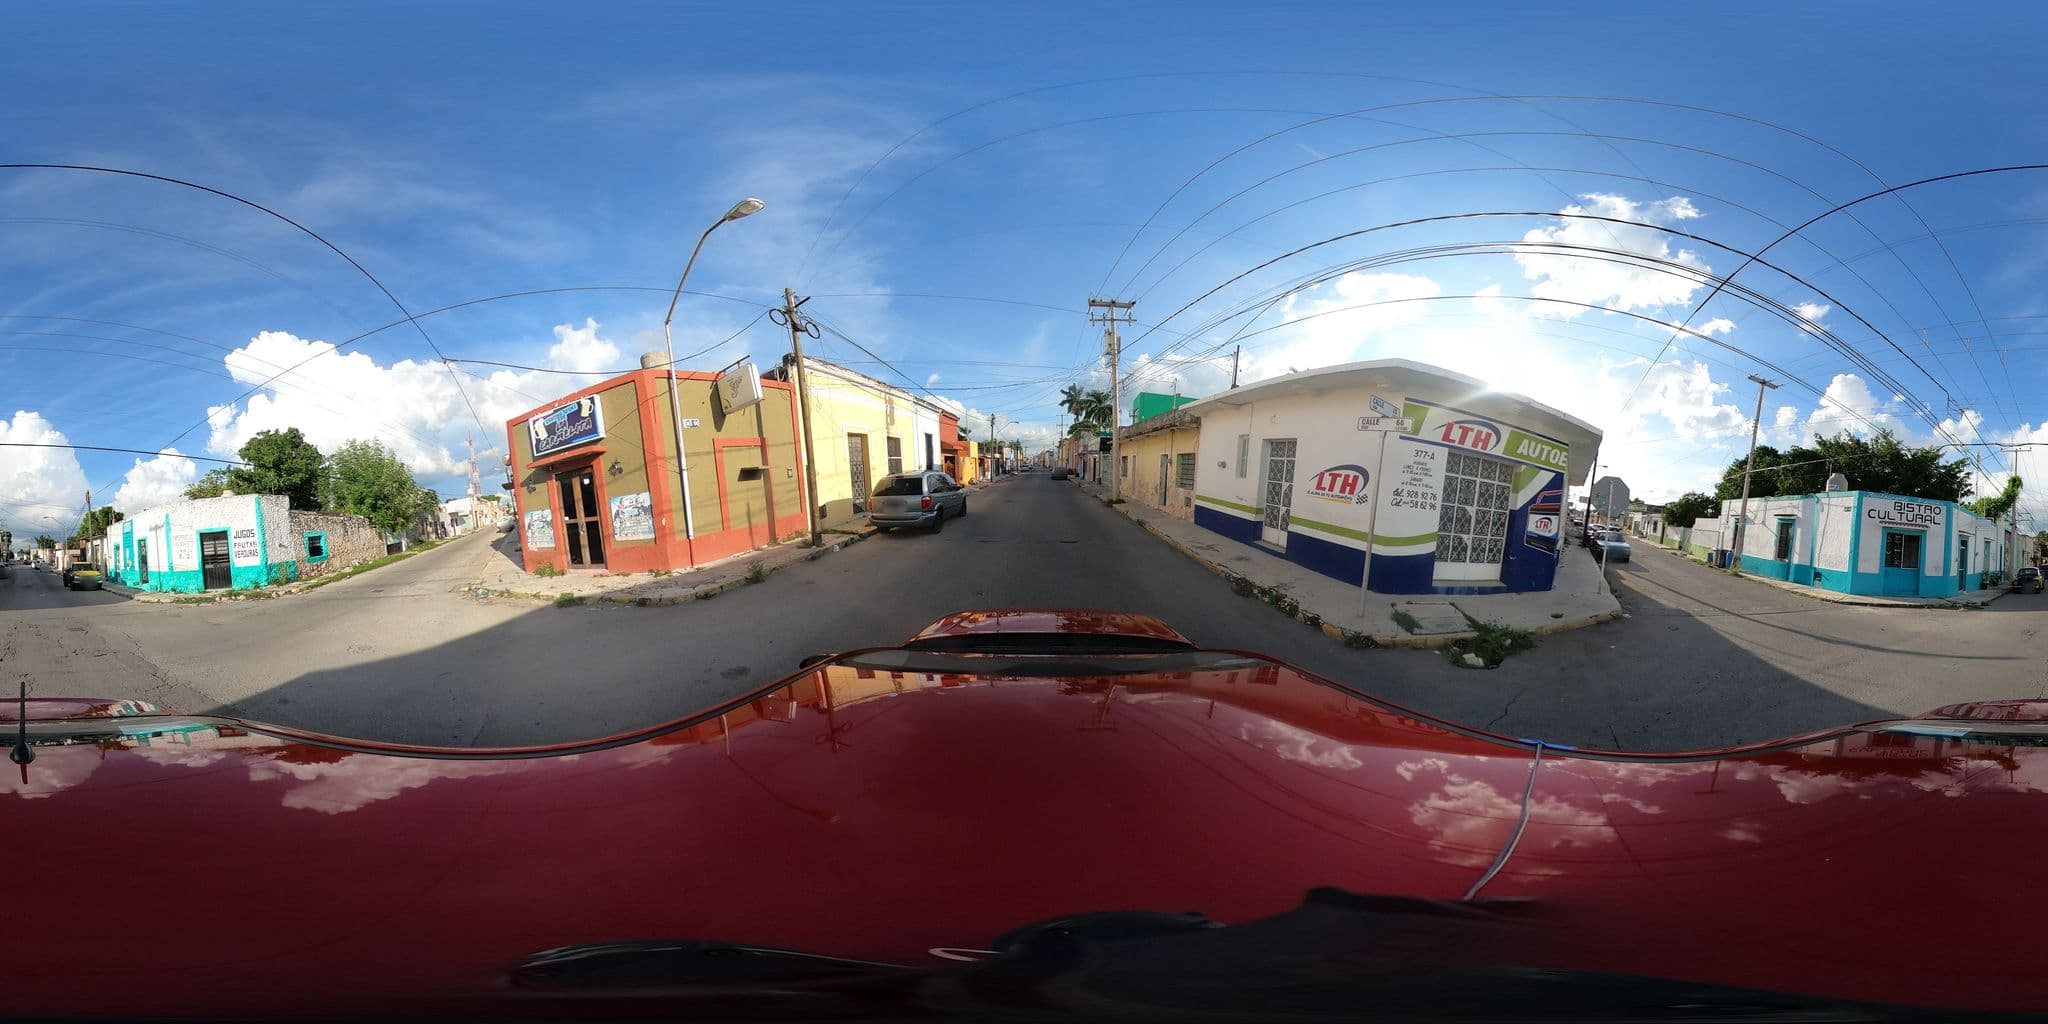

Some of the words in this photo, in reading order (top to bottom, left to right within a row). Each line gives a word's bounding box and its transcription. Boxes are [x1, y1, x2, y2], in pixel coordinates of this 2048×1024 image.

[1372, 397, 1385, 409] CALLE
[1361, 418, 1380, 426] CALLE
[1441, 422, 1492, 451] LTH
[1413, 449, 1435, 460] 377-A
[1315, 471, 1359, 495] LTH
[1406, 490, 1419, 499] 928
[1867, 508, 1941, 525] CULTURAL
[1536, 520, 1550, 529] LTH
[233, 529, 255, 539] JUGOS
[233, 541, 257, 549] FRUTAS
[234, 549, 258, 558] VERDURAS
